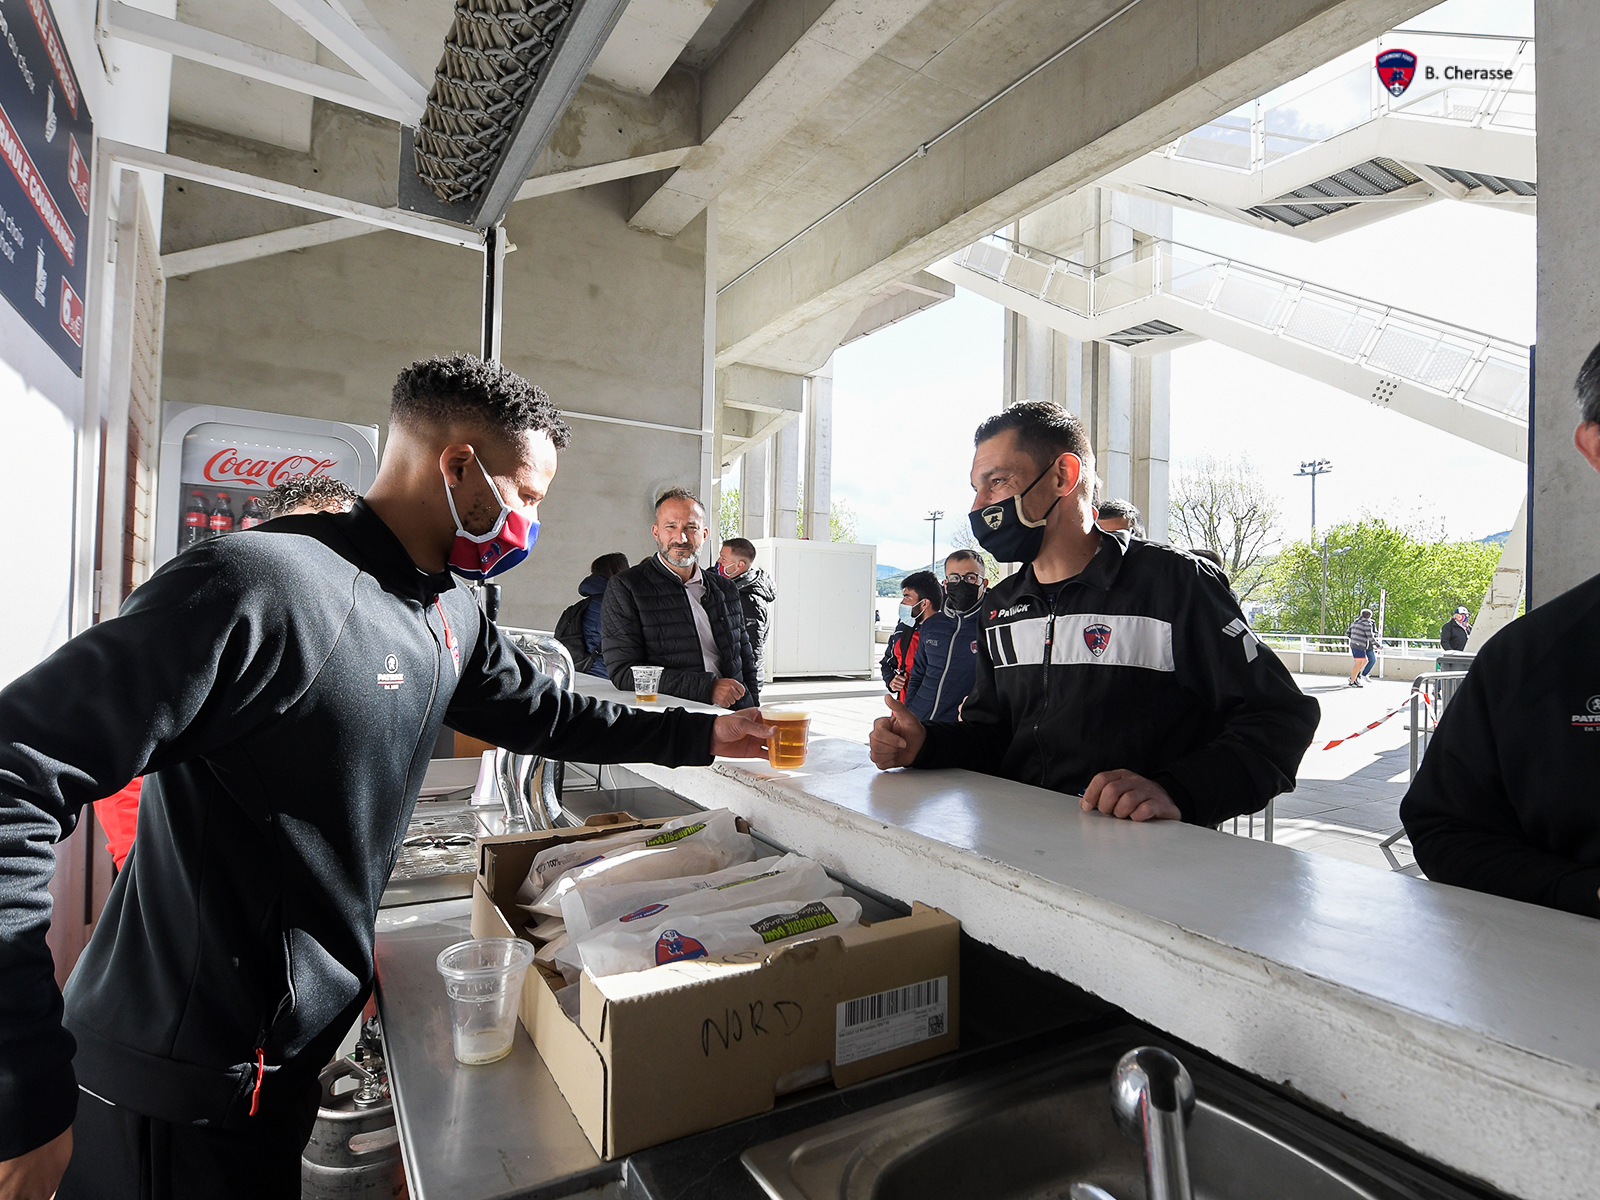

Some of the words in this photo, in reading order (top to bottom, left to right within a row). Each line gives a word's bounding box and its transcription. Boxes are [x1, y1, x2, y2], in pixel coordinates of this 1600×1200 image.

[29, 0, 48, 41] ULE
[203, 447, 339, 488] Coca-Cl
[785, 912, 836, 936] BOULANGERIE
[701, 1000, 803, 1057] NORD
